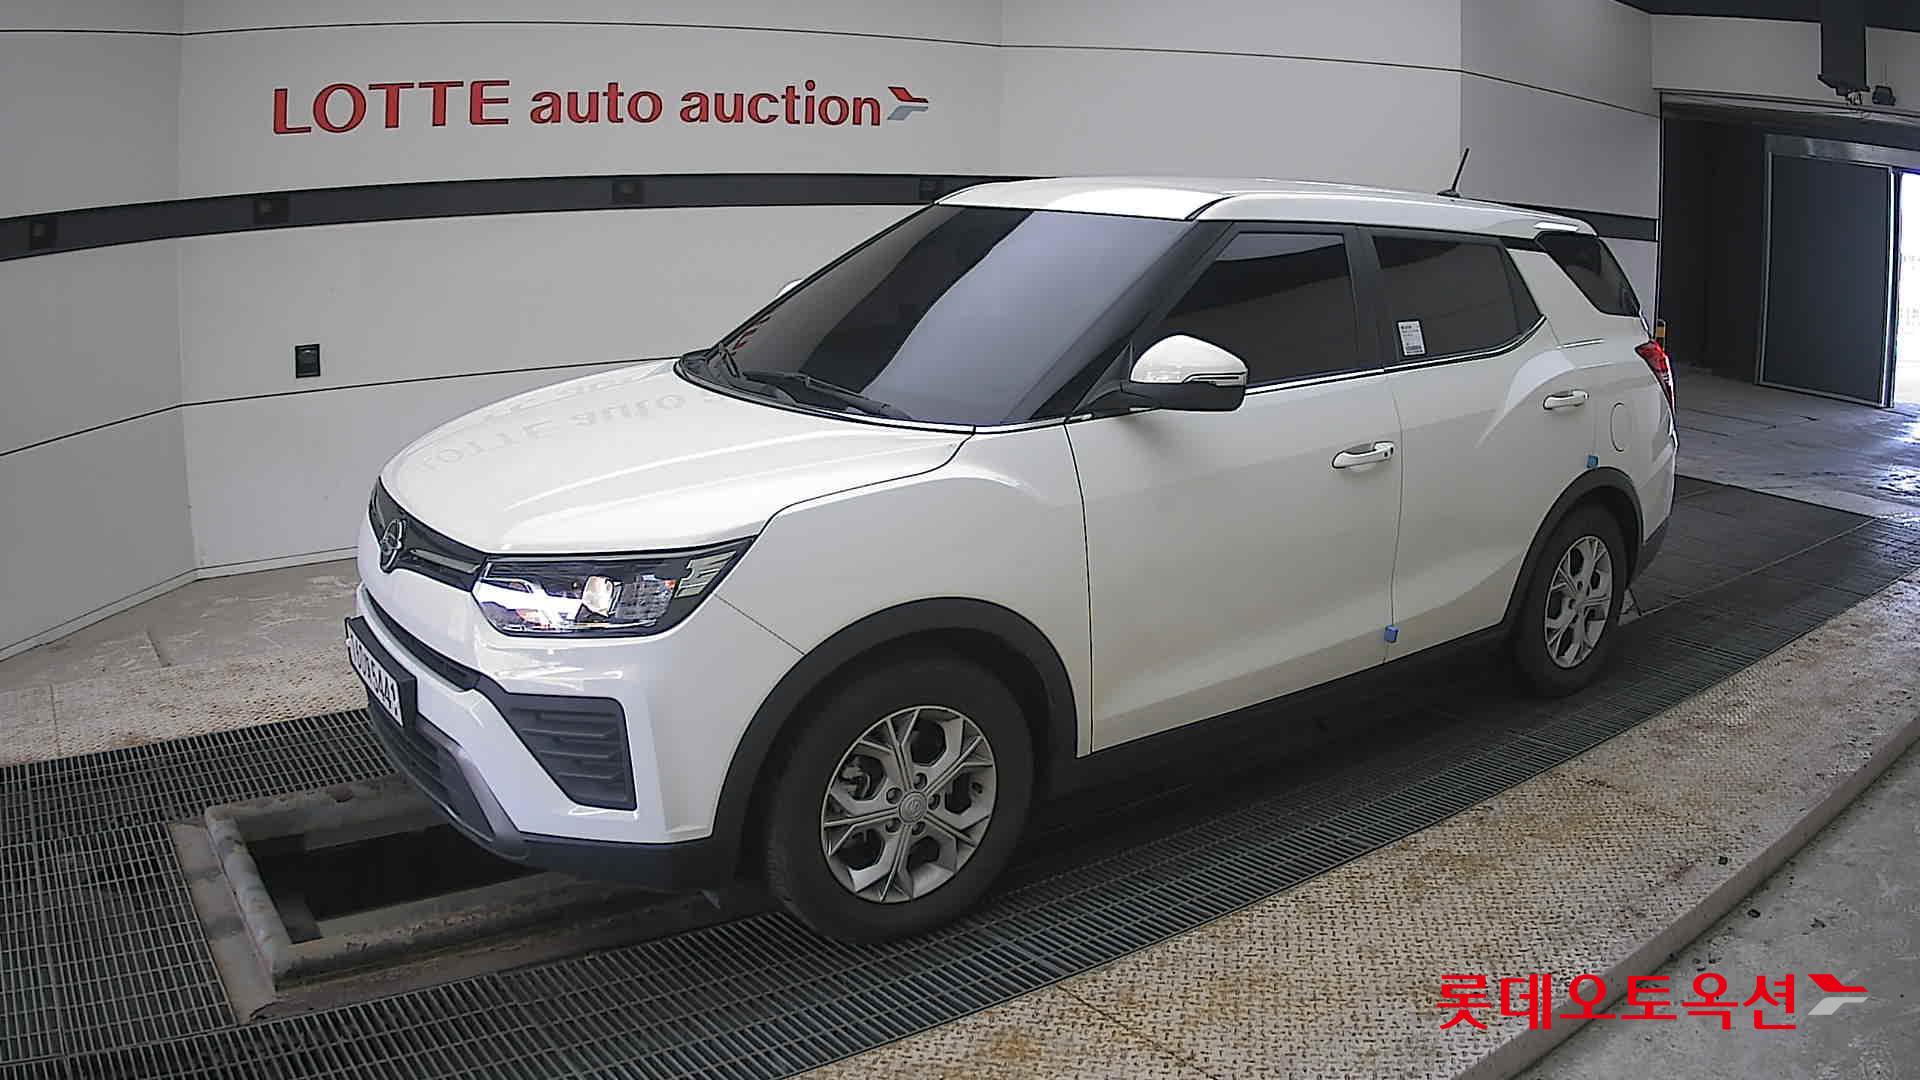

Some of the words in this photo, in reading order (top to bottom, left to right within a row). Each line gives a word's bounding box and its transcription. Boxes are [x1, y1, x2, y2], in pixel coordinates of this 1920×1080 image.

[274, 80, 509, 134] LOTTE
[531, 83, 662, 124] auto
[680, 80, 881, 126] auction
